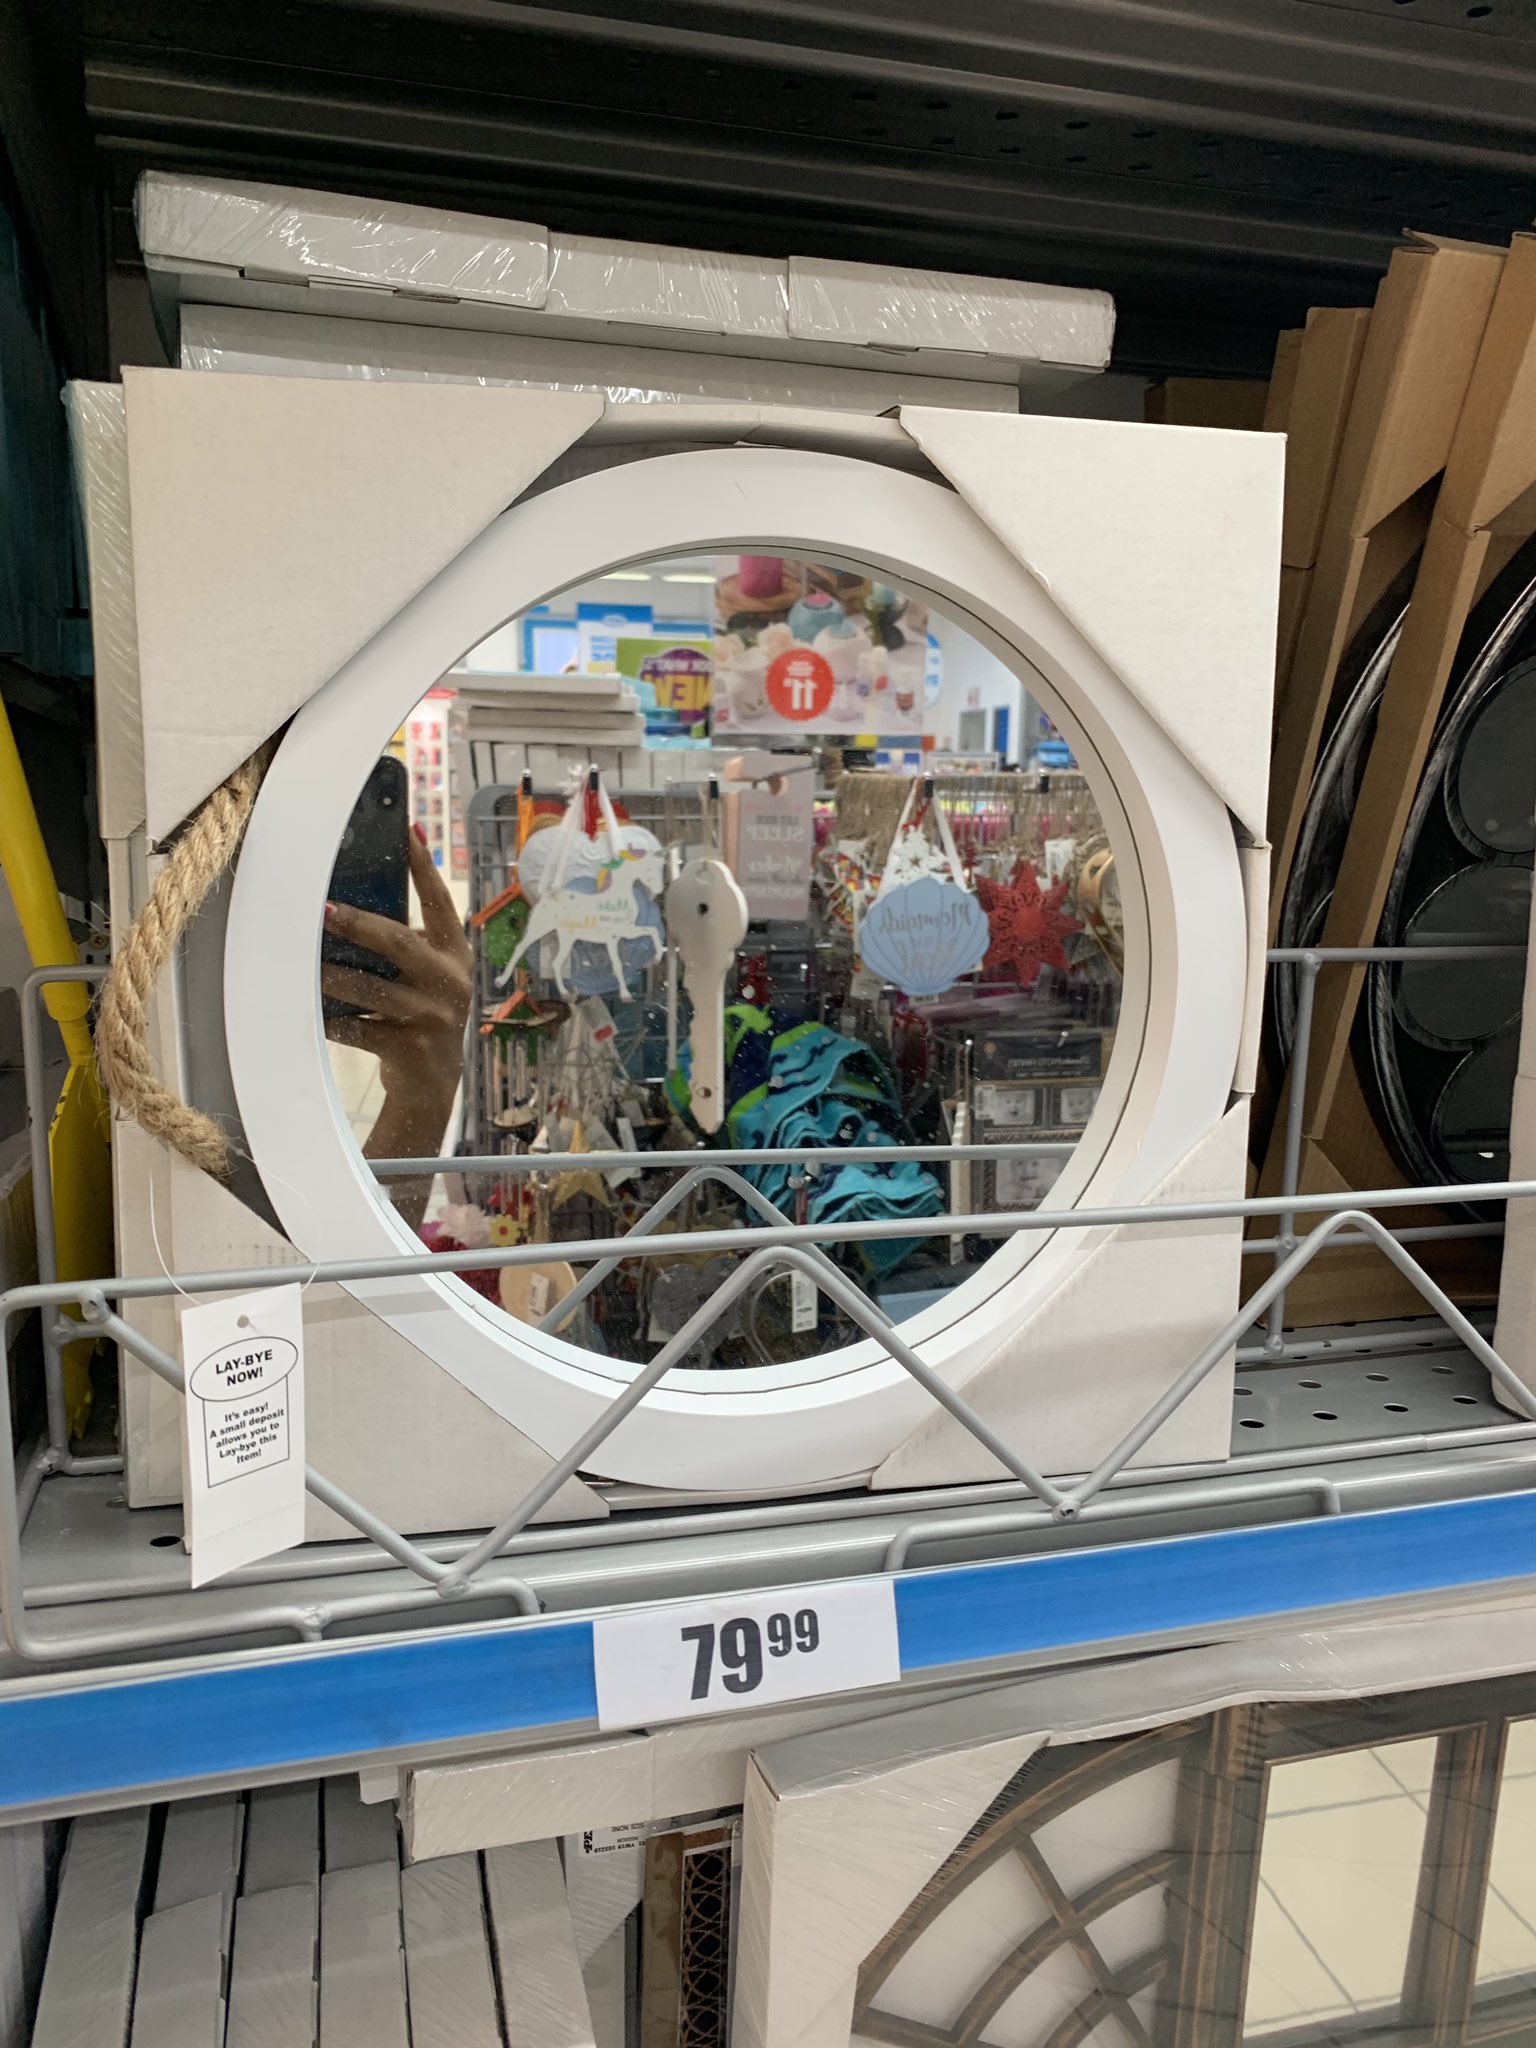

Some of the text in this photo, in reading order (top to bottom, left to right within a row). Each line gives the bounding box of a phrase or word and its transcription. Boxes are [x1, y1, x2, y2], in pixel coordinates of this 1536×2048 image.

[215, 1349, 273, 1375] LAY-BYE
[226, 1366, 263, 1386] NOW!
[209, 1409, 285, 1439] A small deposit
[224, 1401, 269, 1422] It's easy!
[215, 1422, 280, 1448] allows you to
[219, 1434, 277, 1459] Lay-bye this
[236, 1448, 262, 1464] Item!
